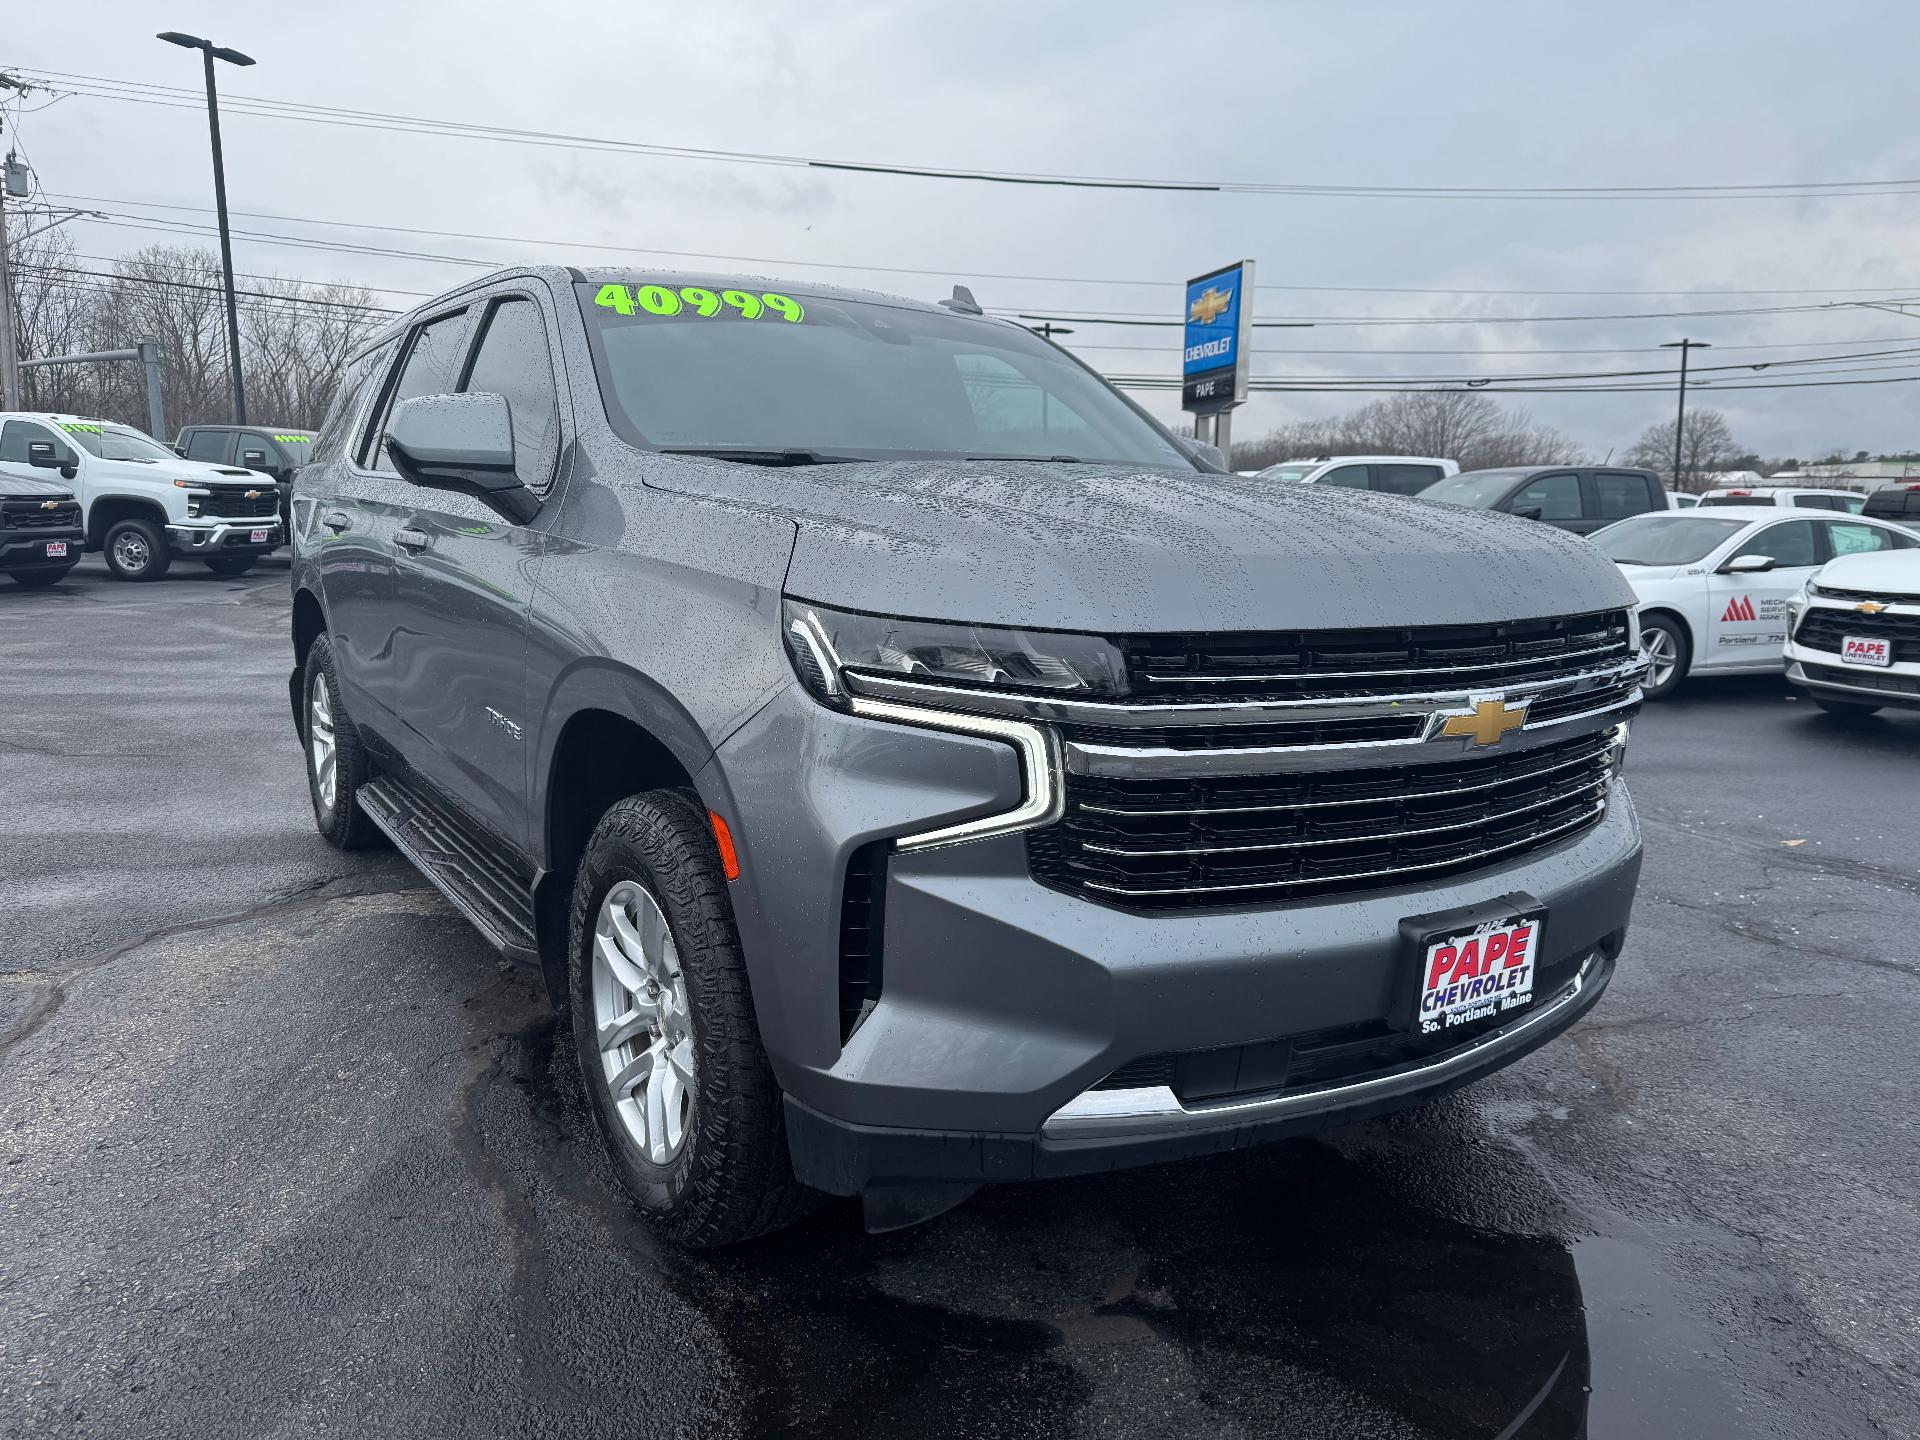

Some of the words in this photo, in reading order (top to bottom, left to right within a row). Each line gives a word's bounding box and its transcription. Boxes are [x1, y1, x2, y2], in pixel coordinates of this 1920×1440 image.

[595, 284, 805, 324] 40999
[1185, 336, 1231, 362] CHEVROLET
[1195, 381, 1215, 398] PAPE
[1718, 636, 1757, 644] Portland
[1846, 641, 1885, 655] PAPE
[1845, 651, 1886, 662] CHEVROLET
[1474, 918, 1507, 935] PAPE
[1427, 926, 1533, 991] PAPE
[1422, 965, 1530, 1012] CHEVROLET
[1468, 996, 1494, 1008] PORTLAND
[1421, 1019, 1441, 1034] So.
[1445, 1001, 1497, 1027] Portland,
[1500, 992, 1532, 1012] Maine
